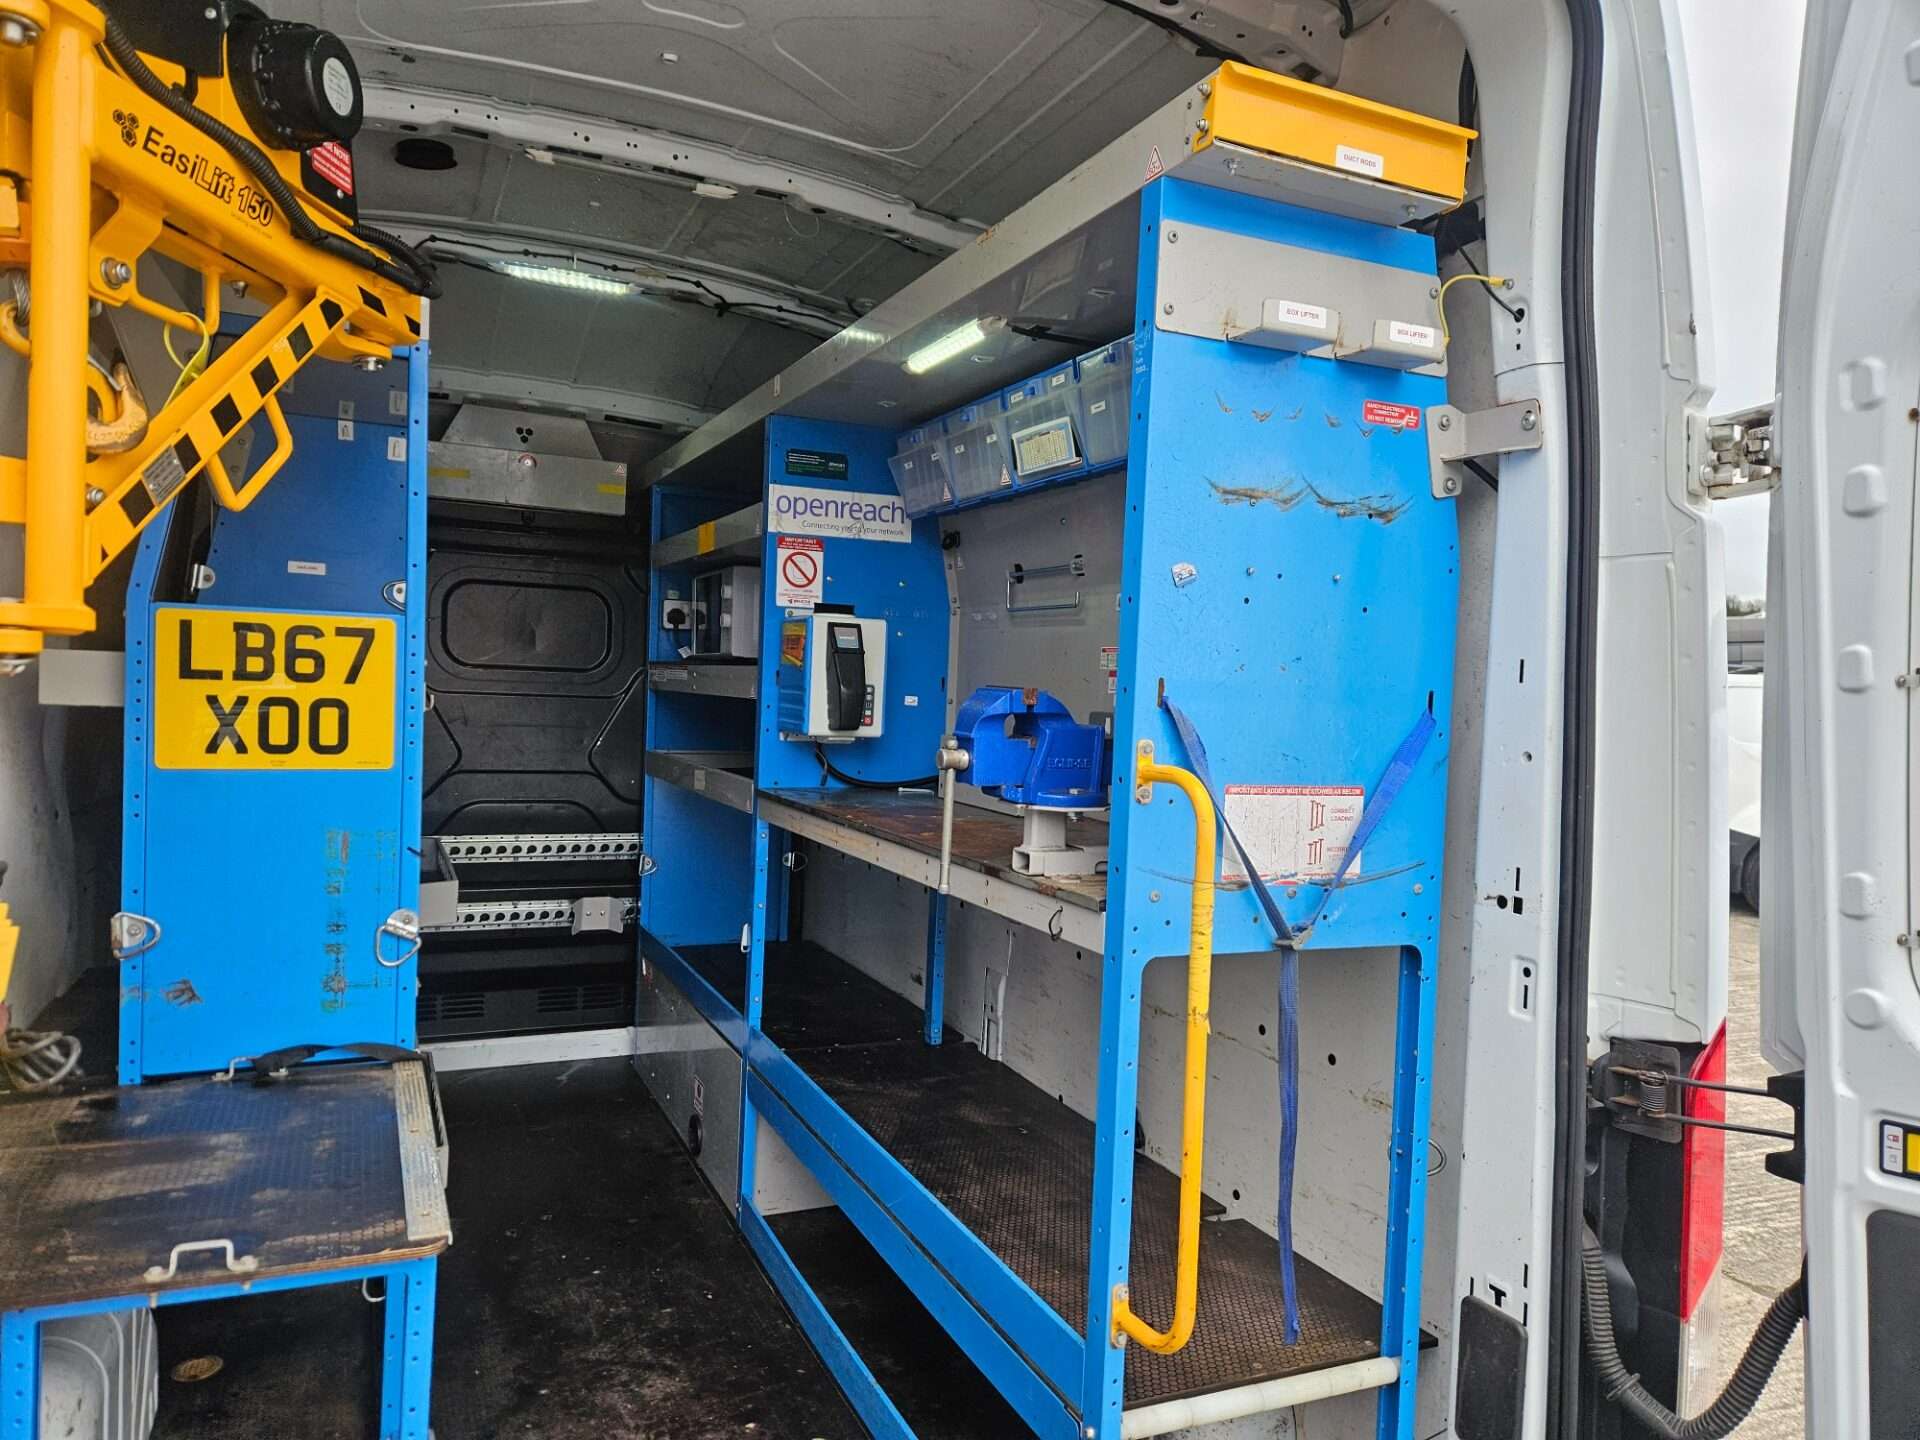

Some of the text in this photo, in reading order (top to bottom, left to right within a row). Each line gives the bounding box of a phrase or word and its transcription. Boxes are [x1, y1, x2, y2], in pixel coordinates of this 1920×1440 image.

[1343, 153, 1359, 164] DUCT
[142, 125, 235, 204] EasiLift
[238, 185, 274, 227] 150
[1286, 307, 1320, 320] BOX LIFTER
[1397, 329, 1428, 340] BOX LIFTER
[776, 494, 905, 524] openreach
[801, 519, 840, 532] Connecting
[863, 526, 878, 536] your
[879, 527, 905, 537] network
[179, 619, 376, 685] LB67
[205, 694, 349, 756] XOO
